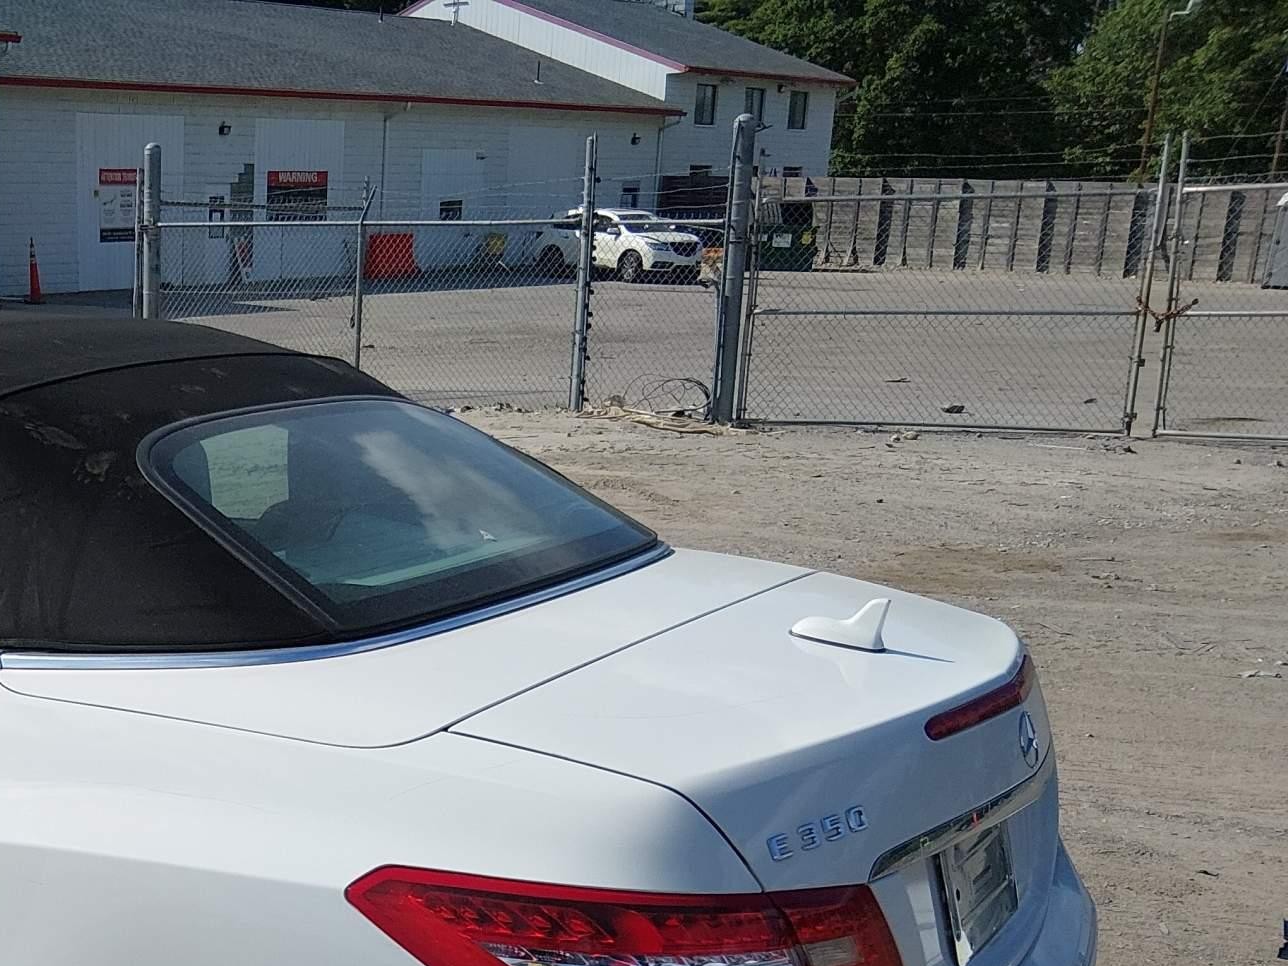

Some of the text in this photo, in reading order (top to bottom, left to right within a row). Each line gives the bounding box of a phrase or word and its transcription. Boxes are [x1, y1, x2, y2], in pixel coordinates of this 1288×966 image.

[278, 171, 318, 183] WARNING
[767, 805, 869, 862] E 350
